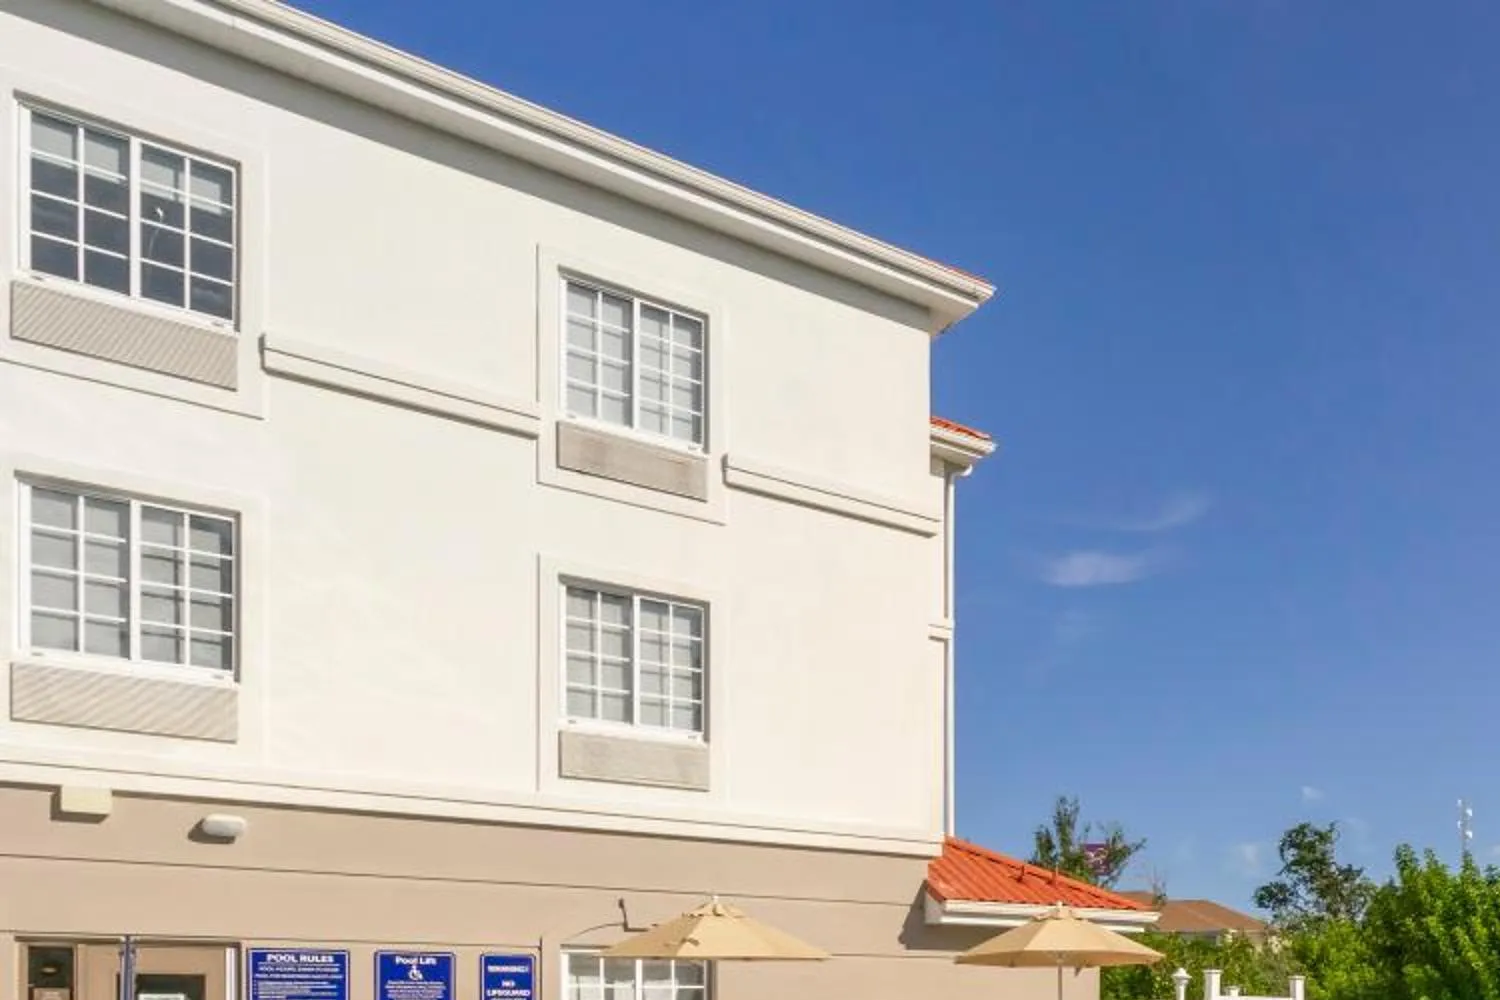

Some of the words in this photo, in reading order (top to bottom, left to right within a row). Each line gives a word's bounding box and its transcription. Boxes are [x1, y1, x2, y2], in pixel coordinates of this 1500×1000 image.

[266, 953, 298, 963] POOL
[300, 954, 334, 963] RULES
[395, 956, 417, 965] Pool
